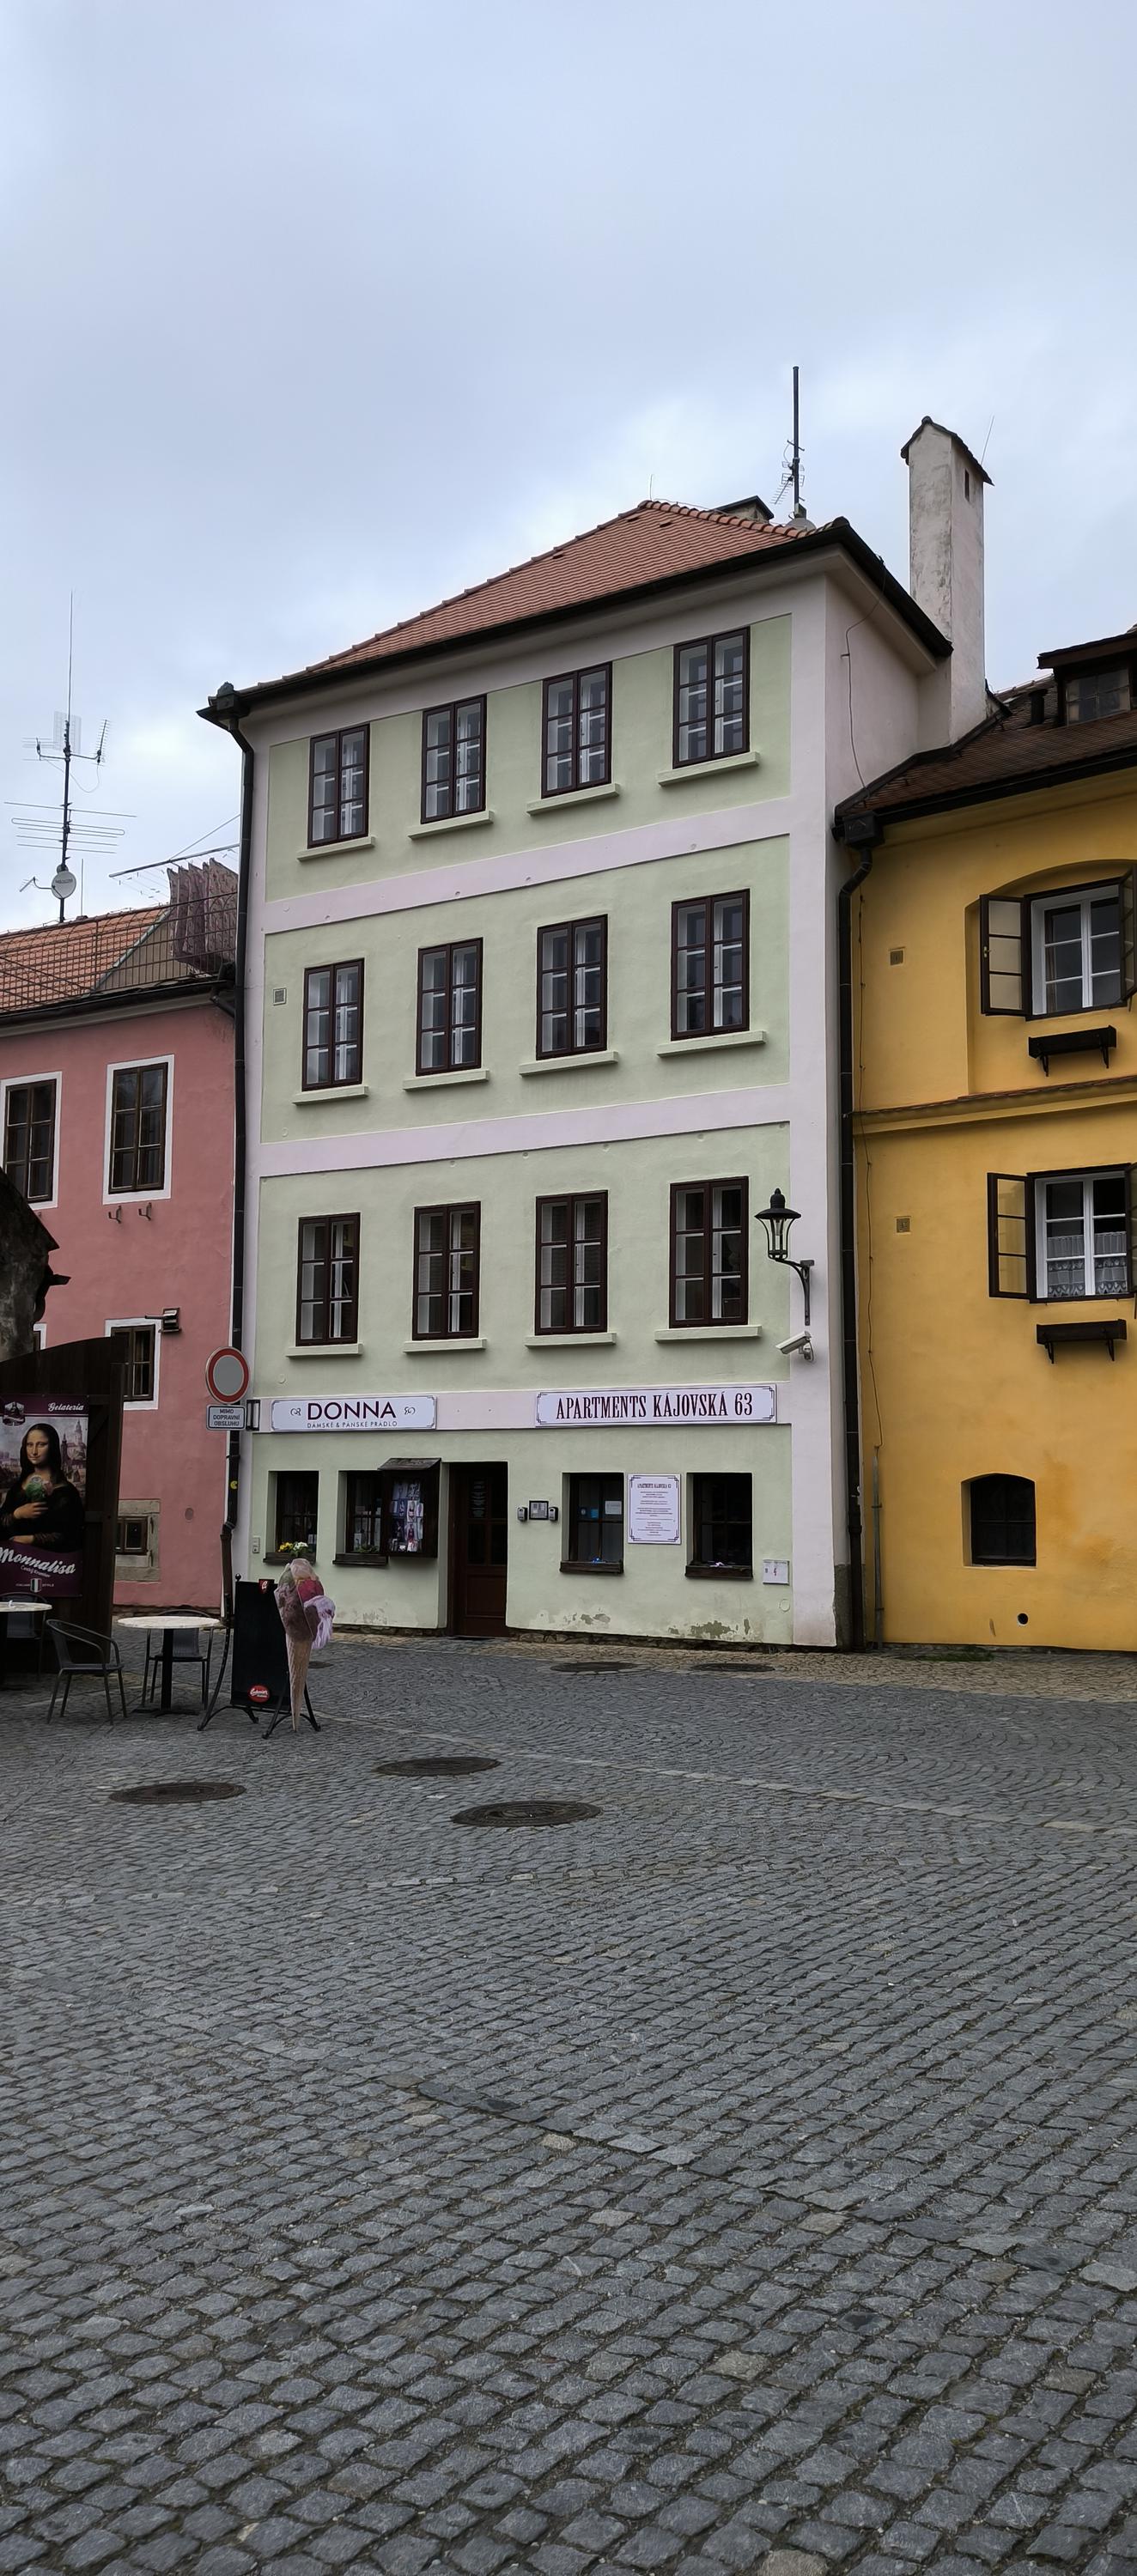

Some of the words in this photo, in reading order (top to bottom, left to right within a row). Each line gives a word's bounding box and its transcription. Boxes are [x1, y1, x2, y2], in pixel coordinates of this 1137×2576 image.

[47, 1401, 85, 1413] Gelateria
[307, 1400, 397, 1420] DONNA
[556, 1394, 647, 1419] APARTMENTS
[653, 1391, 728, 1418] KÁJOVSKÁ
[734, 1392, 753, 1416] 63
[0, 1546, 76, 1575] Monnalisa
